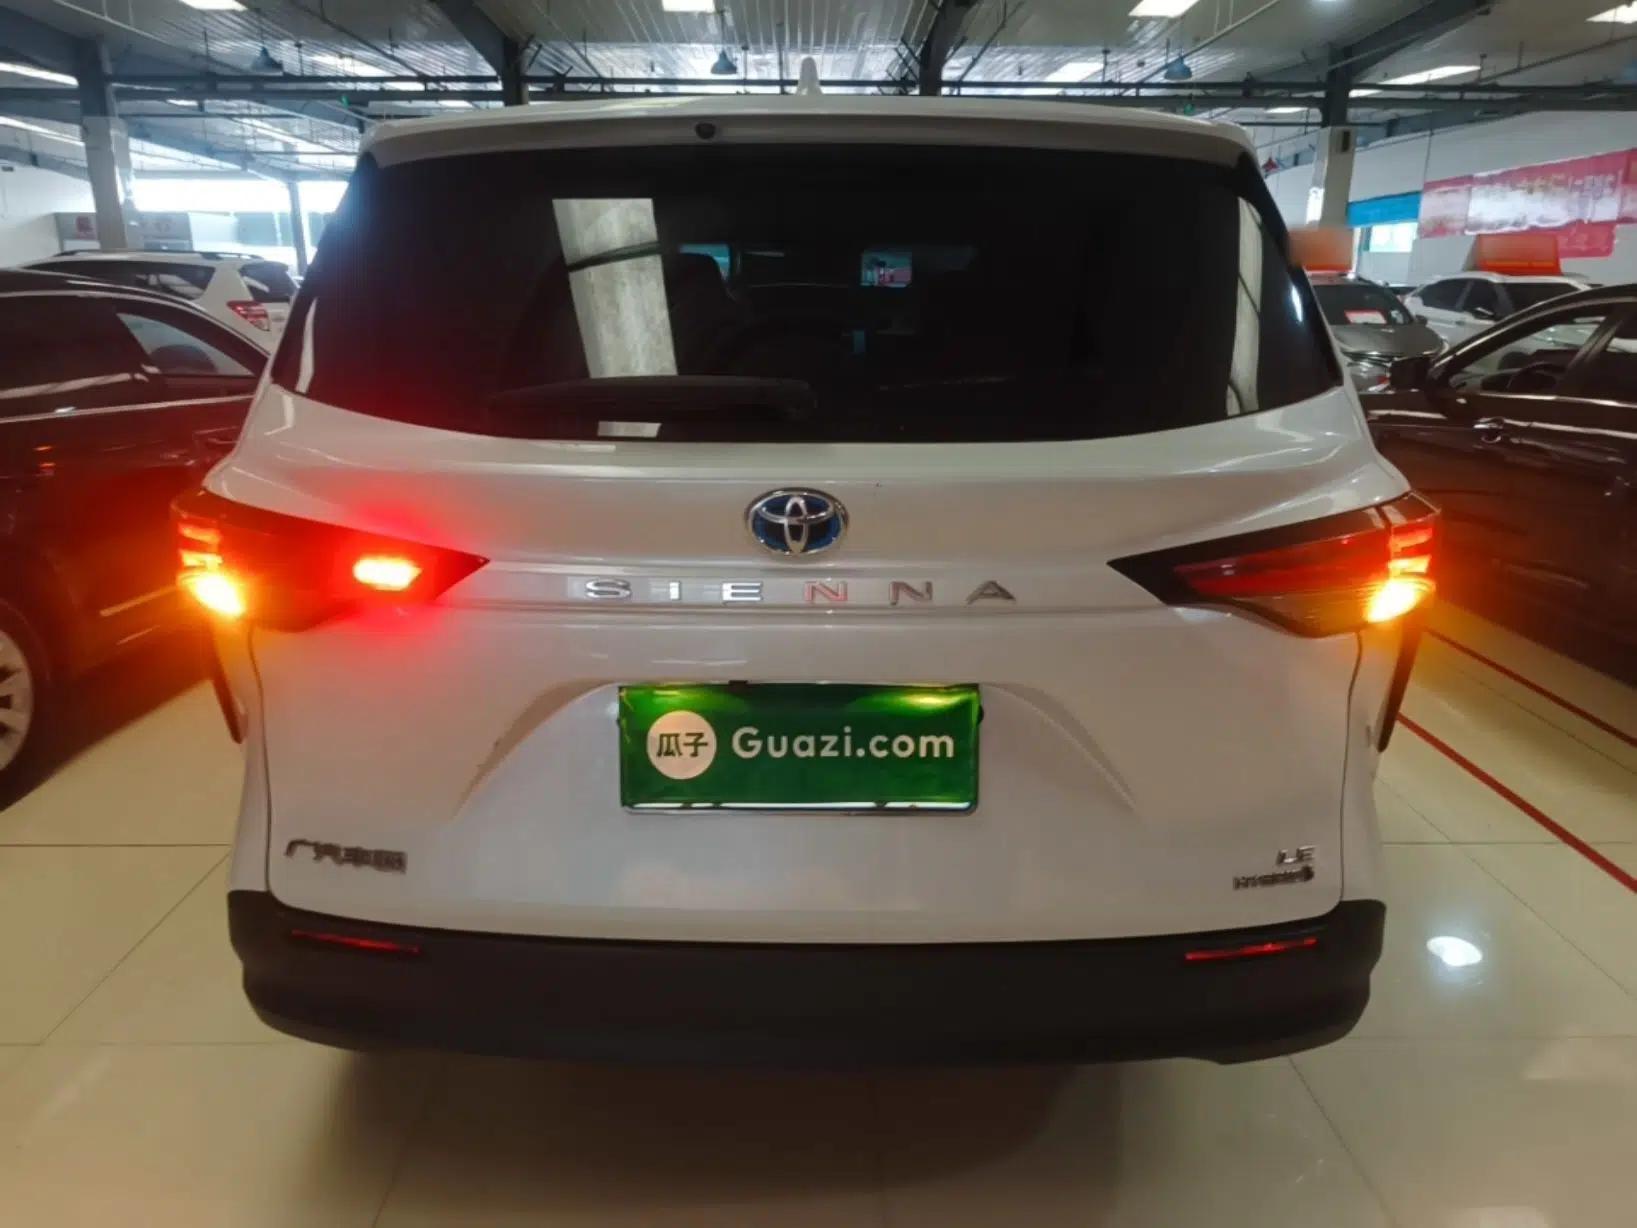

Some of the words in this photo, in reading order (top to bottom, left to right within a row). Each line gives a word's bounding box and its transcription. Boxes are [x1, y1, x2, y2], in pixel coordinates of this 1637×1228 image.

[585, 578, 1016, 606] SIENNA
[656, 731, 709, 760] 瓜子
[731, 725, 955, 759] Guazi.com
